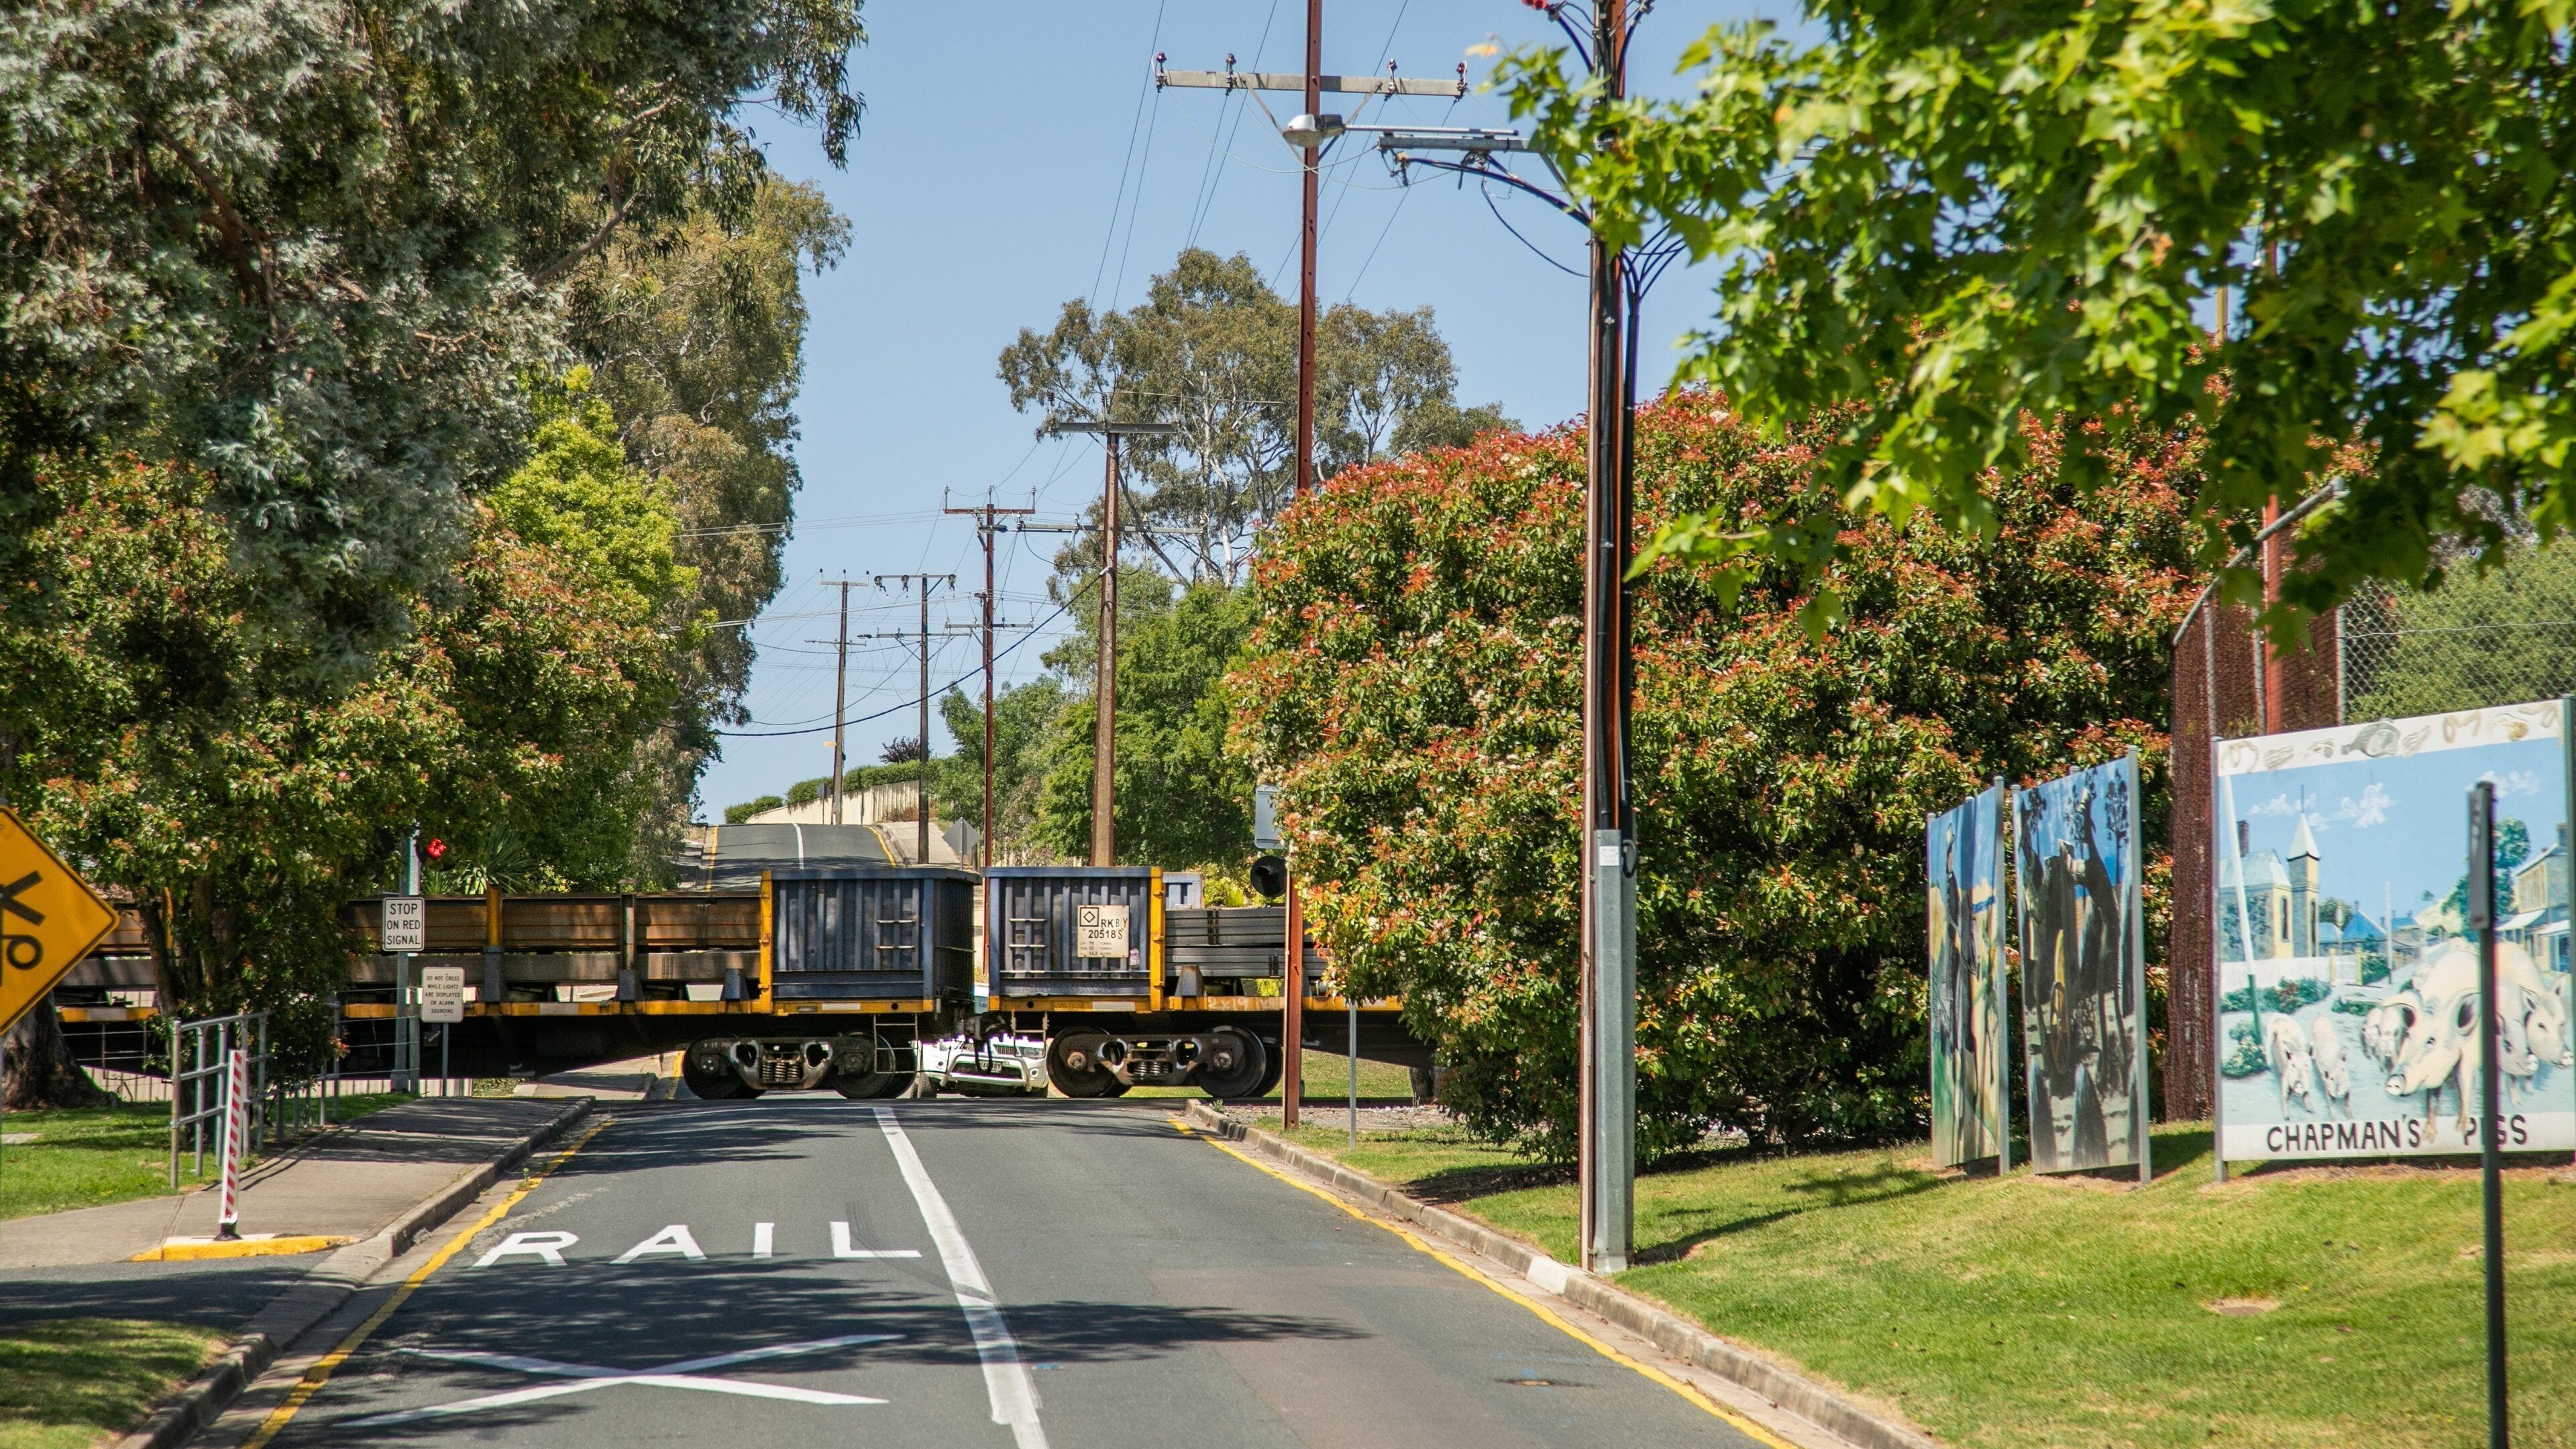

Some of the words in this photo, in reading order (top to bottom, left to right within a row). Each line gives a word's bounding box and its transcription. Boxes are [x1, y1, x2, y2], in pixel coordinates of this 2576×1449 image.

[389, 903, 418, 915] STOP
[386, 920, 399, 930] ON
[402, 920, 421, 930] RED
[1101, 918, 1128, 928] RKBY
[386, 935, 421, 945] SIGNAL
[2267, 1114, 2422, 1152] CHAPMAN'S
[2463, 1114, 2529, 1146] PGS
[471, 1221, 922, 1267] RAIL
